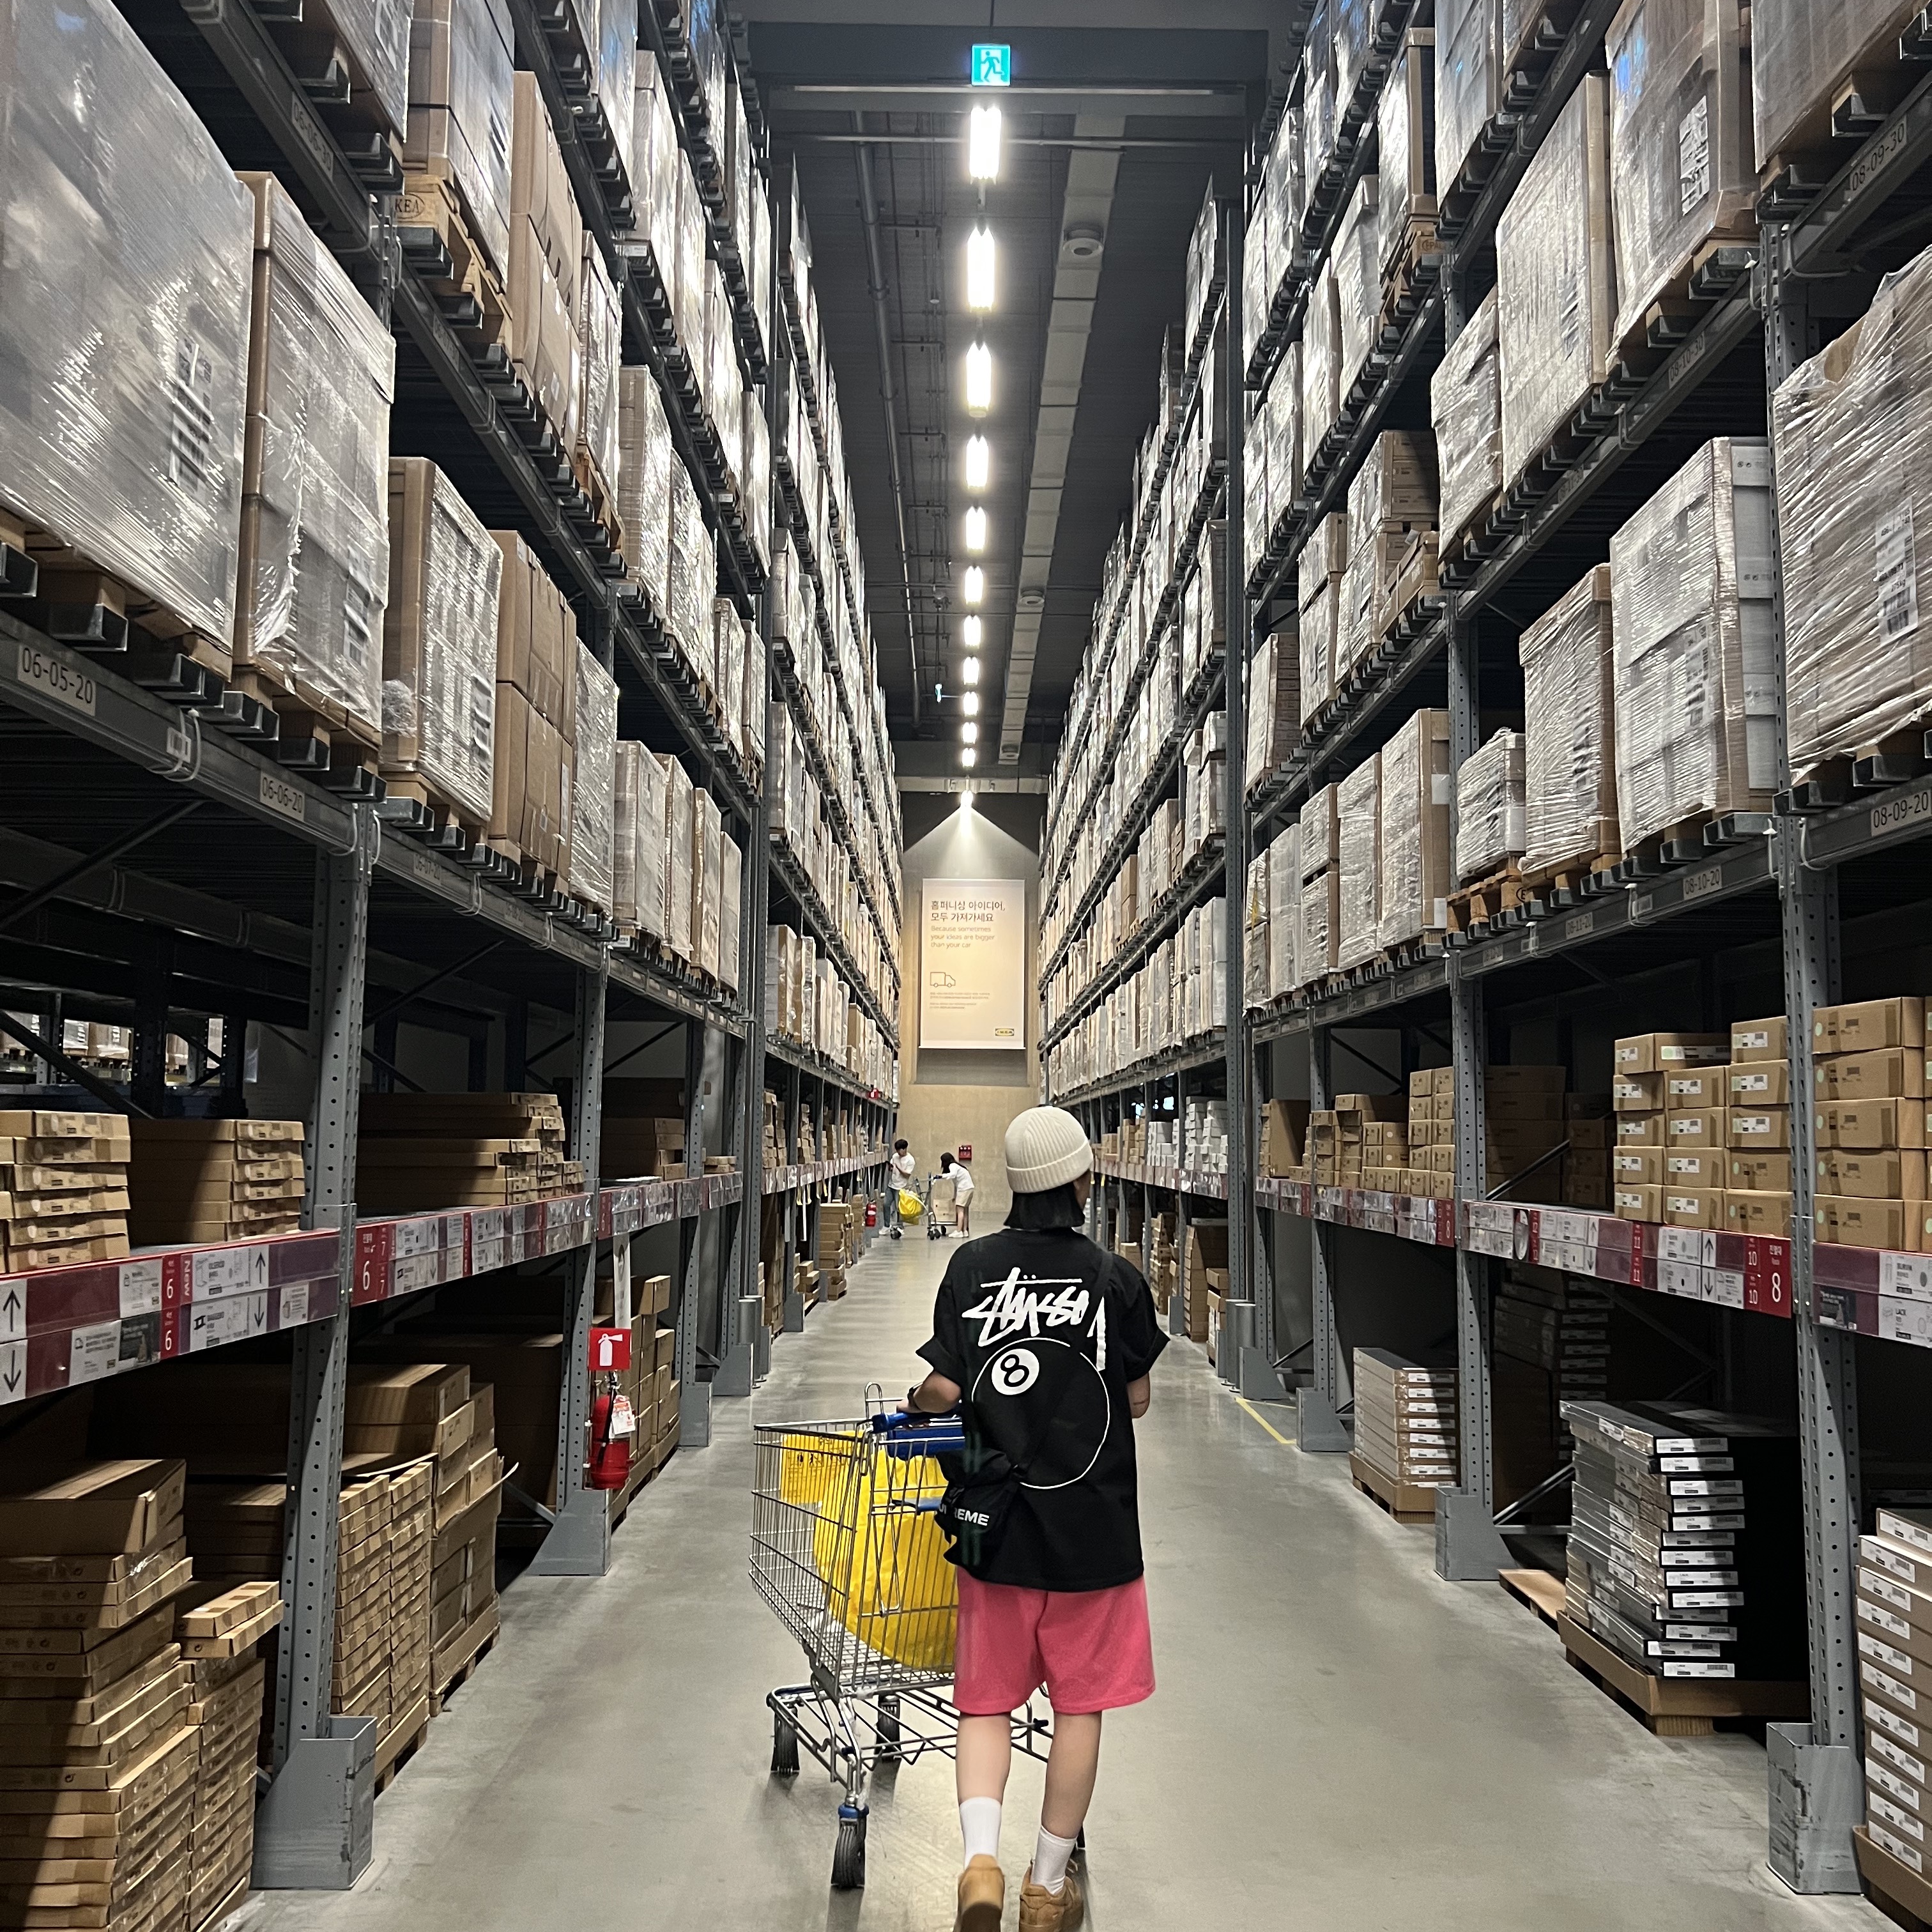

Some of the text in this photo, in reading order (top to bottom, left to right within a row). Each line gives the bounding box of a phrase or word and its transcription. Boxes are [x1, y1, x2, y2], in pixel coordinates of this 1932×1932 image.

[1852, 123, 1905, 190] 08-09-30
[395, 198, 420, 213] KEA
[1670, 334, 1703, 381] 08-10-30
[22, 647, 93, 703] 06-05-20
[262, 777, 303, 813] 06-06-20
[1873, 792, 1929, 828] 08-09-20
[1685, 868, 1720, 894] 08-10-20
[931, 900, 1005, 911] 홈퍼니싱 아이디어,
[931, 912, 948, 922] 모두
[381, 1241, 386, 1256] 7
[1748, 1251, 1757, 1266] 10
[363, 1260, 370, 1291] 6
[167, 1278, 173, 1299] 6
[380, 1280, 385, 1295] 7
[1749, 1289, 1758, 1305] 10
[1772, 1272, 1781, 1303] 8
[165, 1330, 172, 1351] 6
[1000, 1354, 1029, 1387] 8
